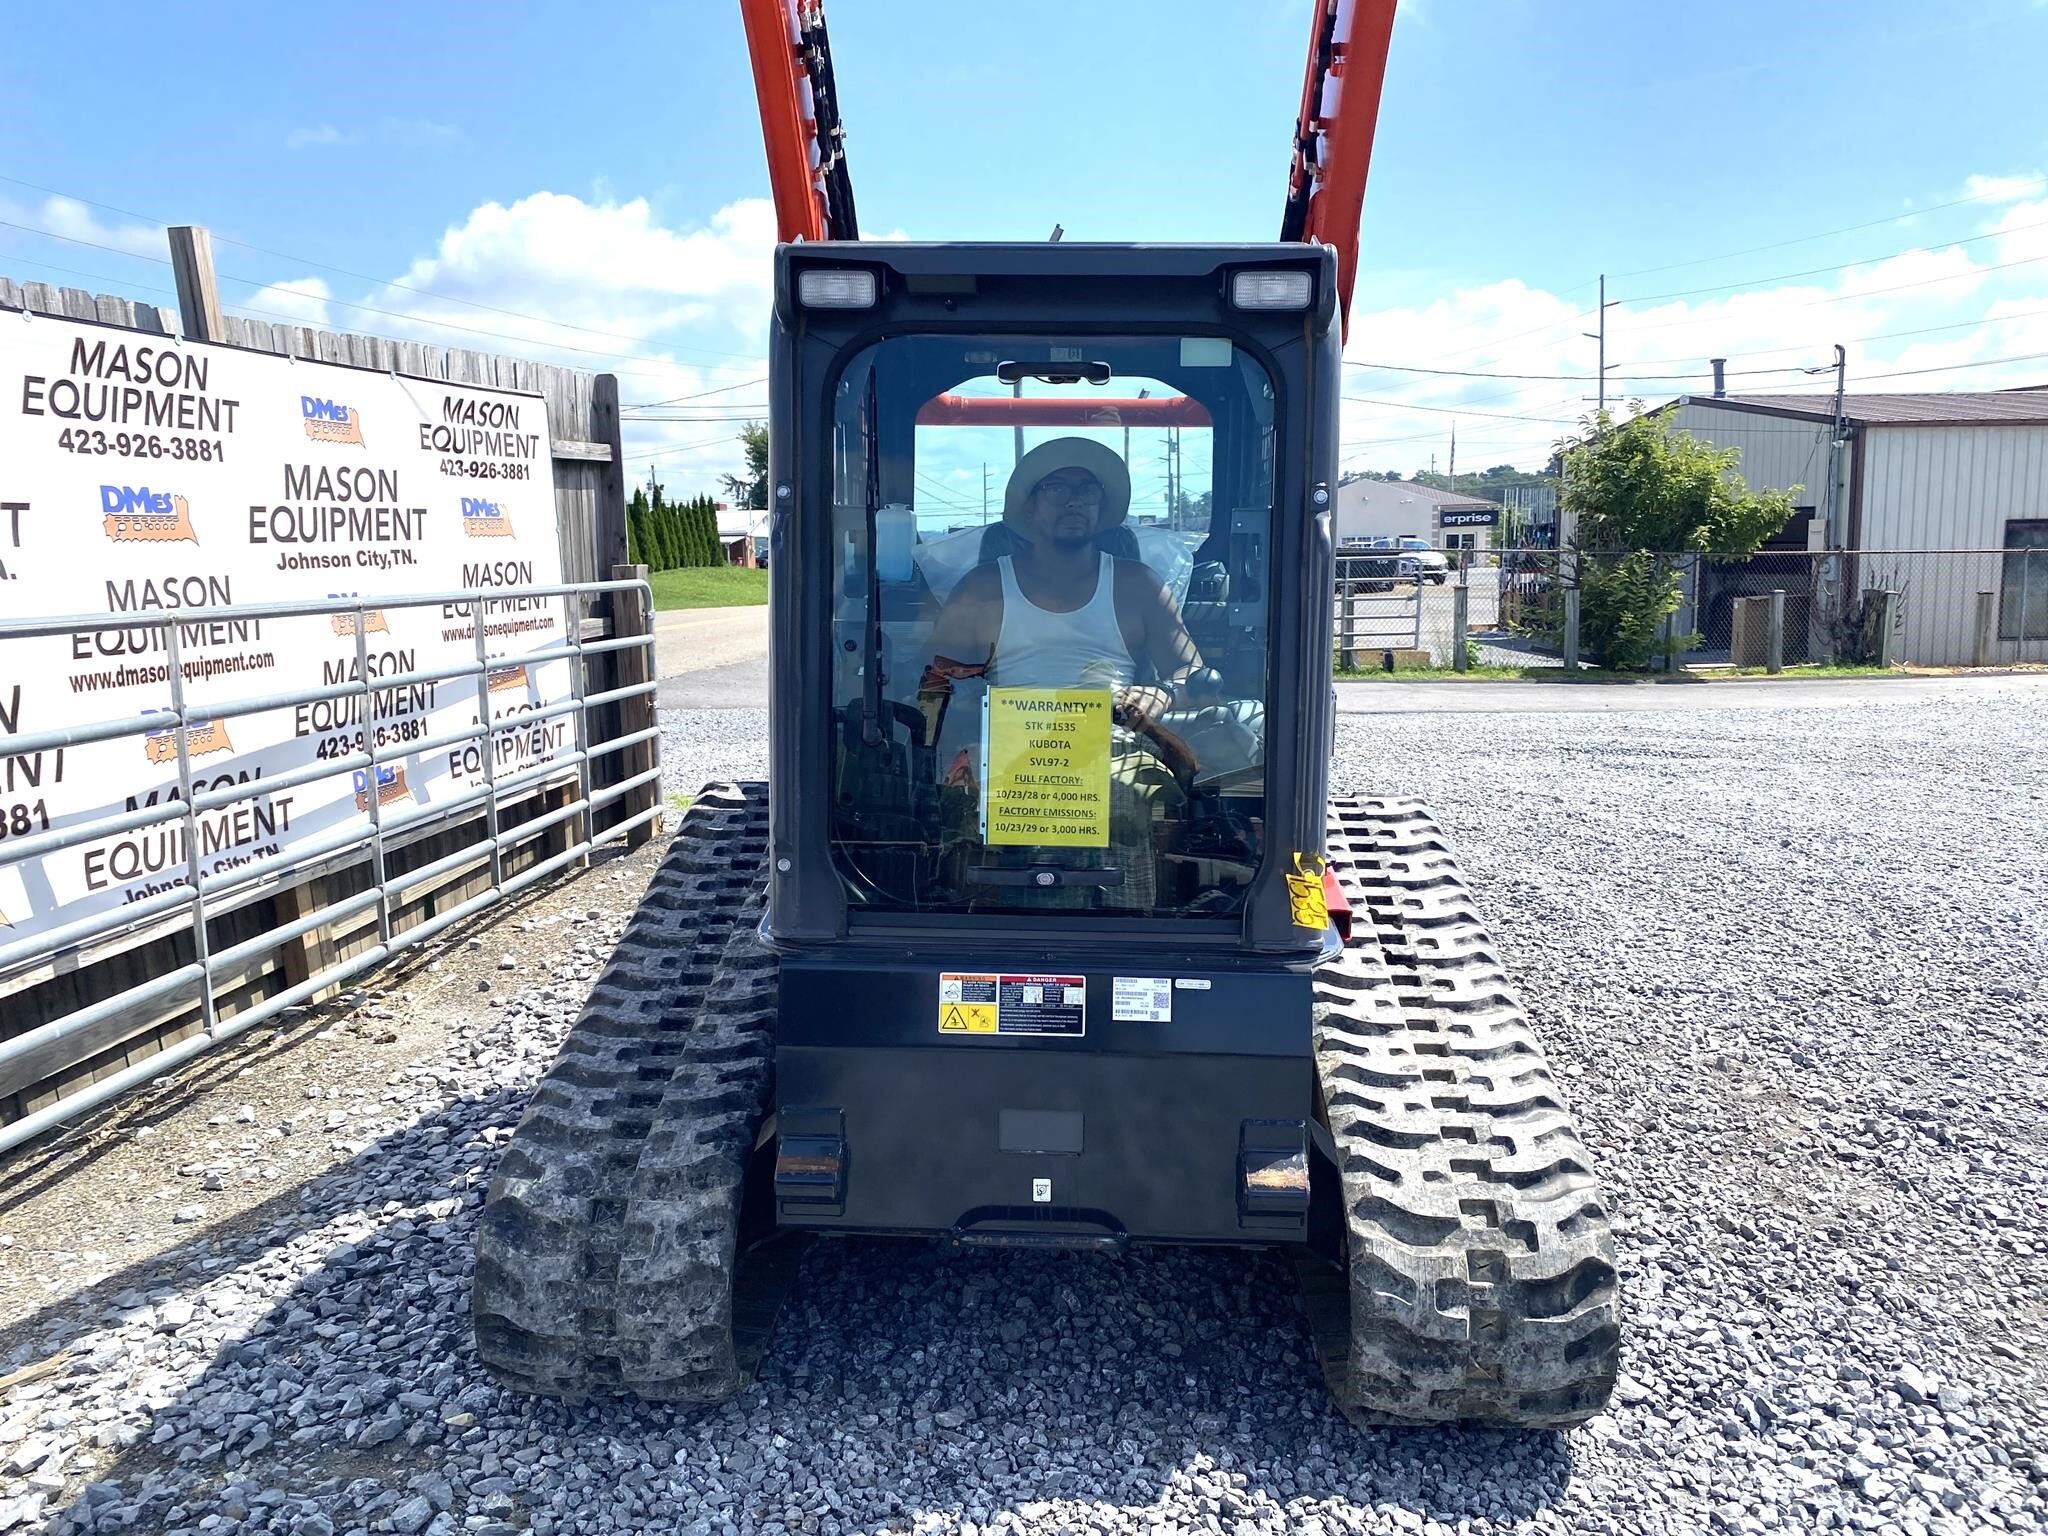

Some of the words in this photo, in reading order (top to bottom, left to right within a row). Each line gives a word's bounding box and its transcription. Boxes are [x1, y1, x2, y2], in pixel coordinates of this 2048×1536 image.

[70, 337, 208, 391] MASON
[22, 375, 240, 433] EQUIPMENT
[443, 396, 519, 430] MASON
[58, 428, 224, 462] 423-926-3881
[419, 423, 539, 459] EQUIPMENT
[440, 459, 530, 480] 423-926-3881
[284, 463, 398, 503] MASON
[249, 505, 427, 544] EQUIPMENT
[1443, 513, 1491, 525] erprise
[276, 551, 351, 570] Johnson
[462, 561, 533, 589] MASON
[105, 575, 232, 612] MASON
[443, 597, 547, 619] EQIPMENT
[316, 716, 428, 760] 423-96-3881
[1025, 721, 1043, 730] STK
[1046, 722, 1076, 732] #1535
[448, 722, 566, 780] EQIPMENT
[1029, 739, 1071, 750] KUBOTA
[1029, 757, 1070, 768] SVL97-2
[1014, 774, 1036, 783] FULL
[1038, 775, 1083, 785] FACTORY:
[996, 790, 1039, 800] 10/23/28
[1040, 792, 1051, 800] or
[1052, 791, 1078, 801] 4,000
[1080, 792, 1101, 802] HRS.
[999, 807, 1040, 816] FACTORY
[1043, 808, 1097, 818] EMISSIONS:
[995, 823, 1037, 833] 10/23/29
[1039, 825, 1050, 833] or
[1051, 824, 1077, 834] 3,000
[1079, 825, 1100, 835] HRS.
